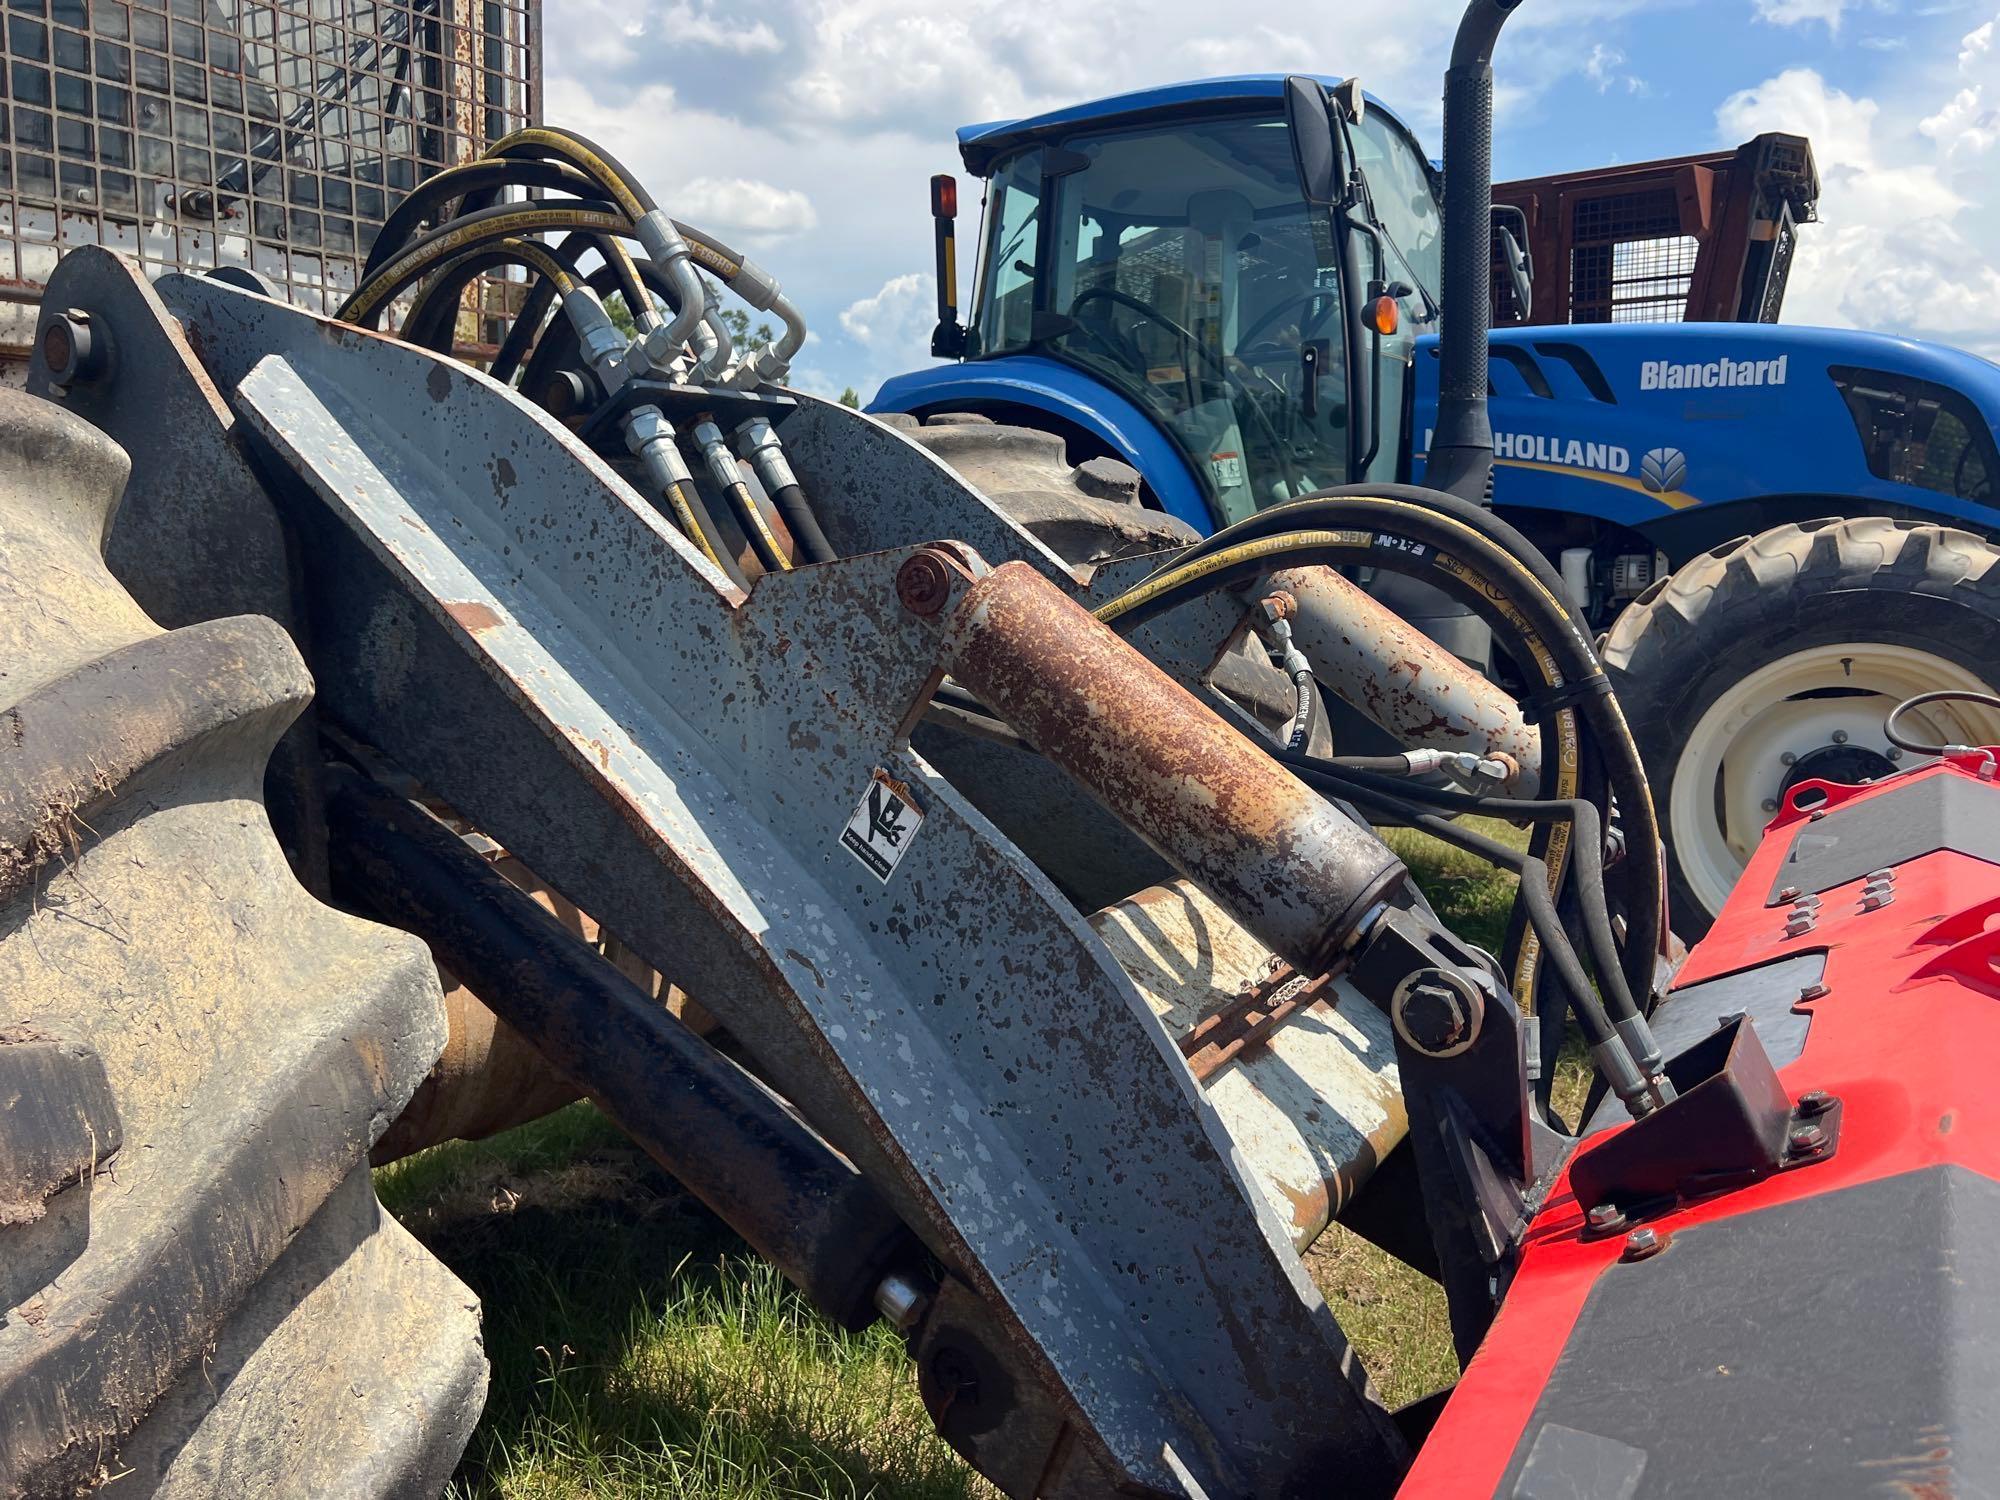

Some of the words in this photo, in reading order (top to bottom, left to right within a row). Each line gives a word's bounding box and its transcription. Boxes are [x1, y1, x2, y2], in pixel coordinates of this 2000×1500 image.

[1640, 355, 1788, 391] Blanchard
[1494, 432, 1630, 474] HOLLAND
[845, 832, 860, 848] Keep
[859, 843, 875, 862] hands
[874, 858, 888, 873] clear
